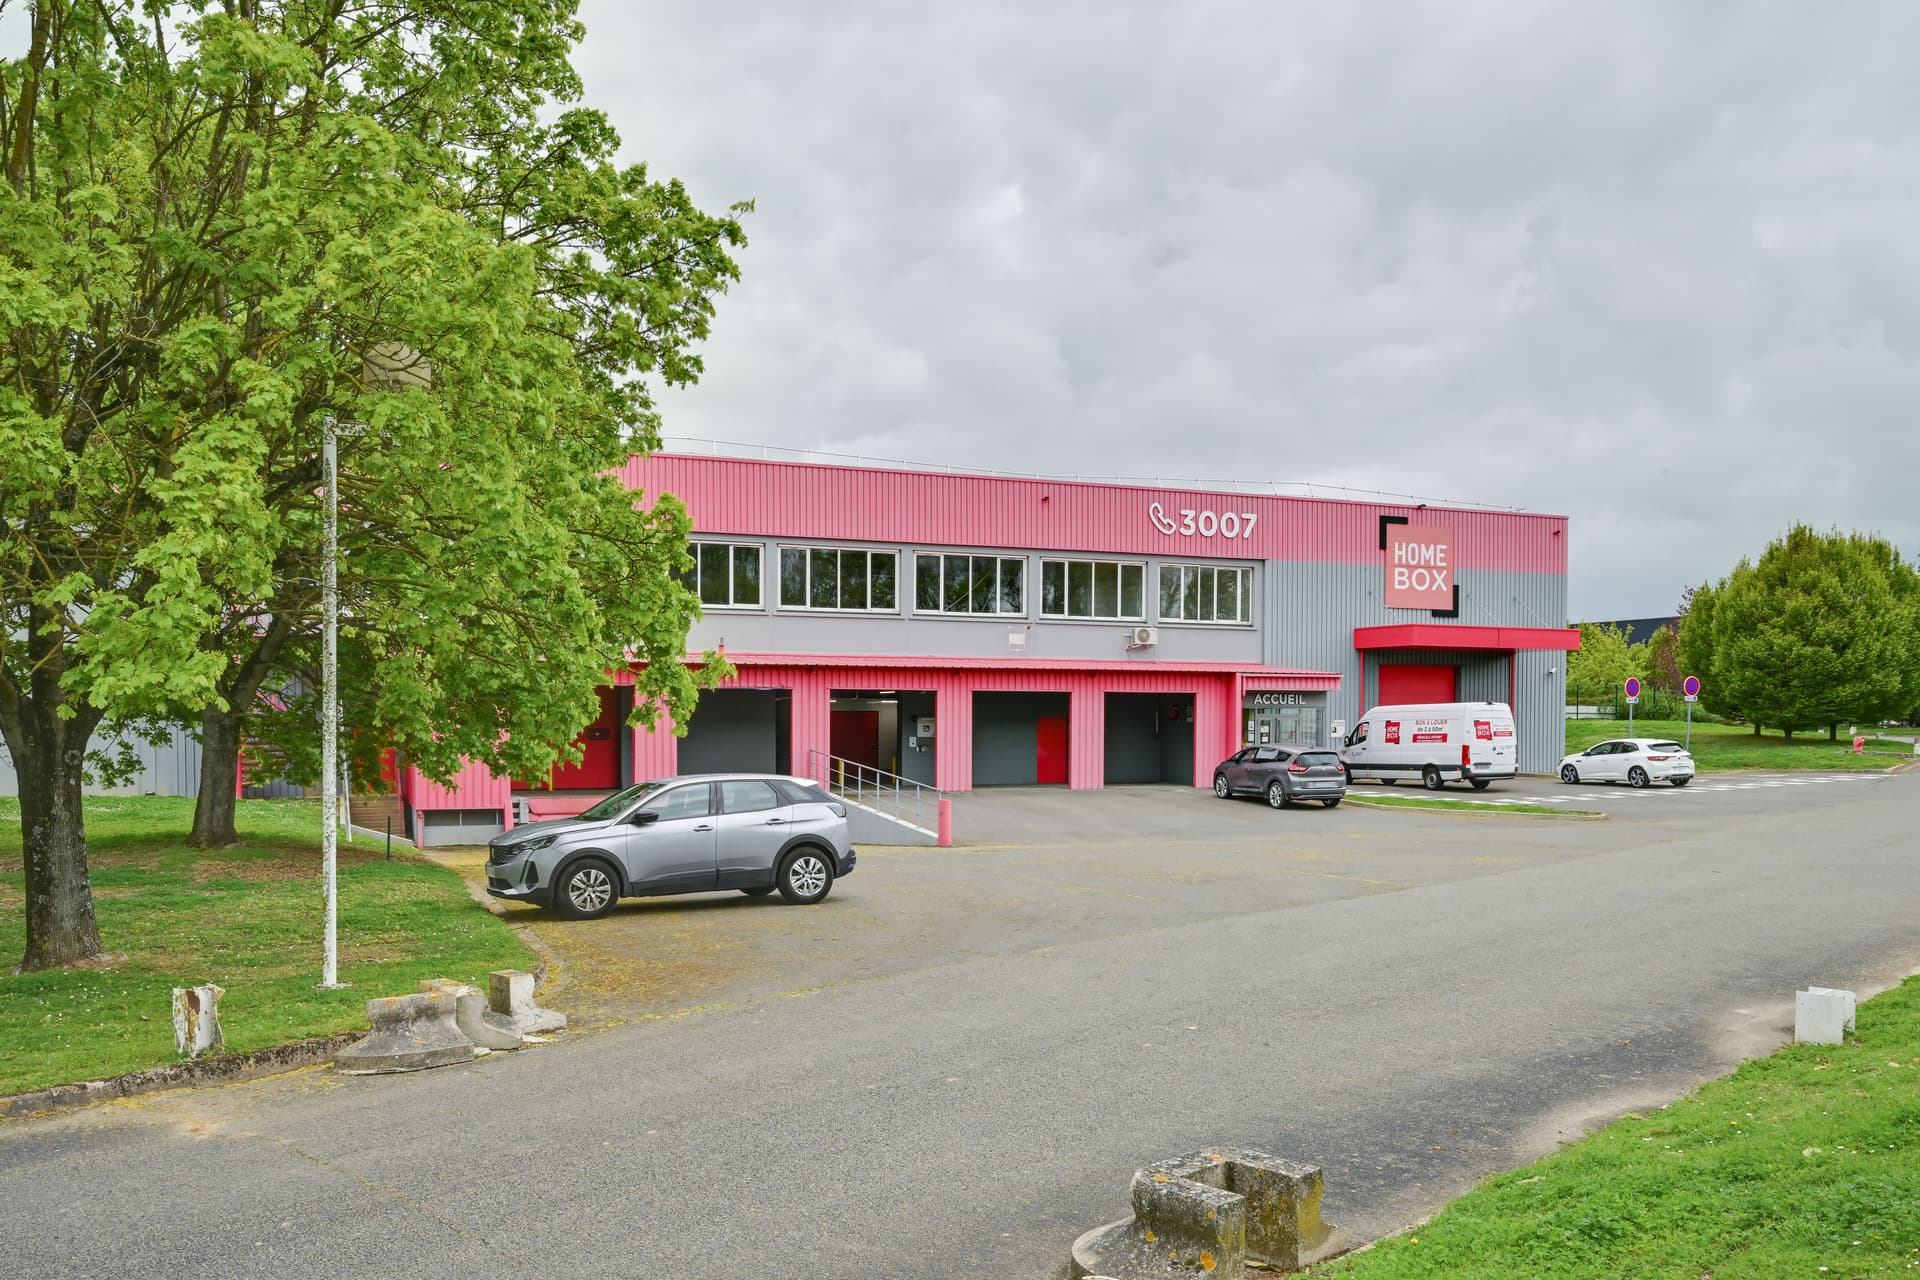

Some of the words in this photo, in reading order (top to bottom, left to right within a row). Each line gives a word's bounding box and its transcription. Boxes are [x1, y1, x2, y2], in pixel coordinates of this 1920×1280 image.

[1179, 509, 1258, 539] 3007
[1394, 541, 1448, 567] HOME
[1394, 567, 1448, 592] BOX
[1253, 693, 1306, 706] ACCUEIL
